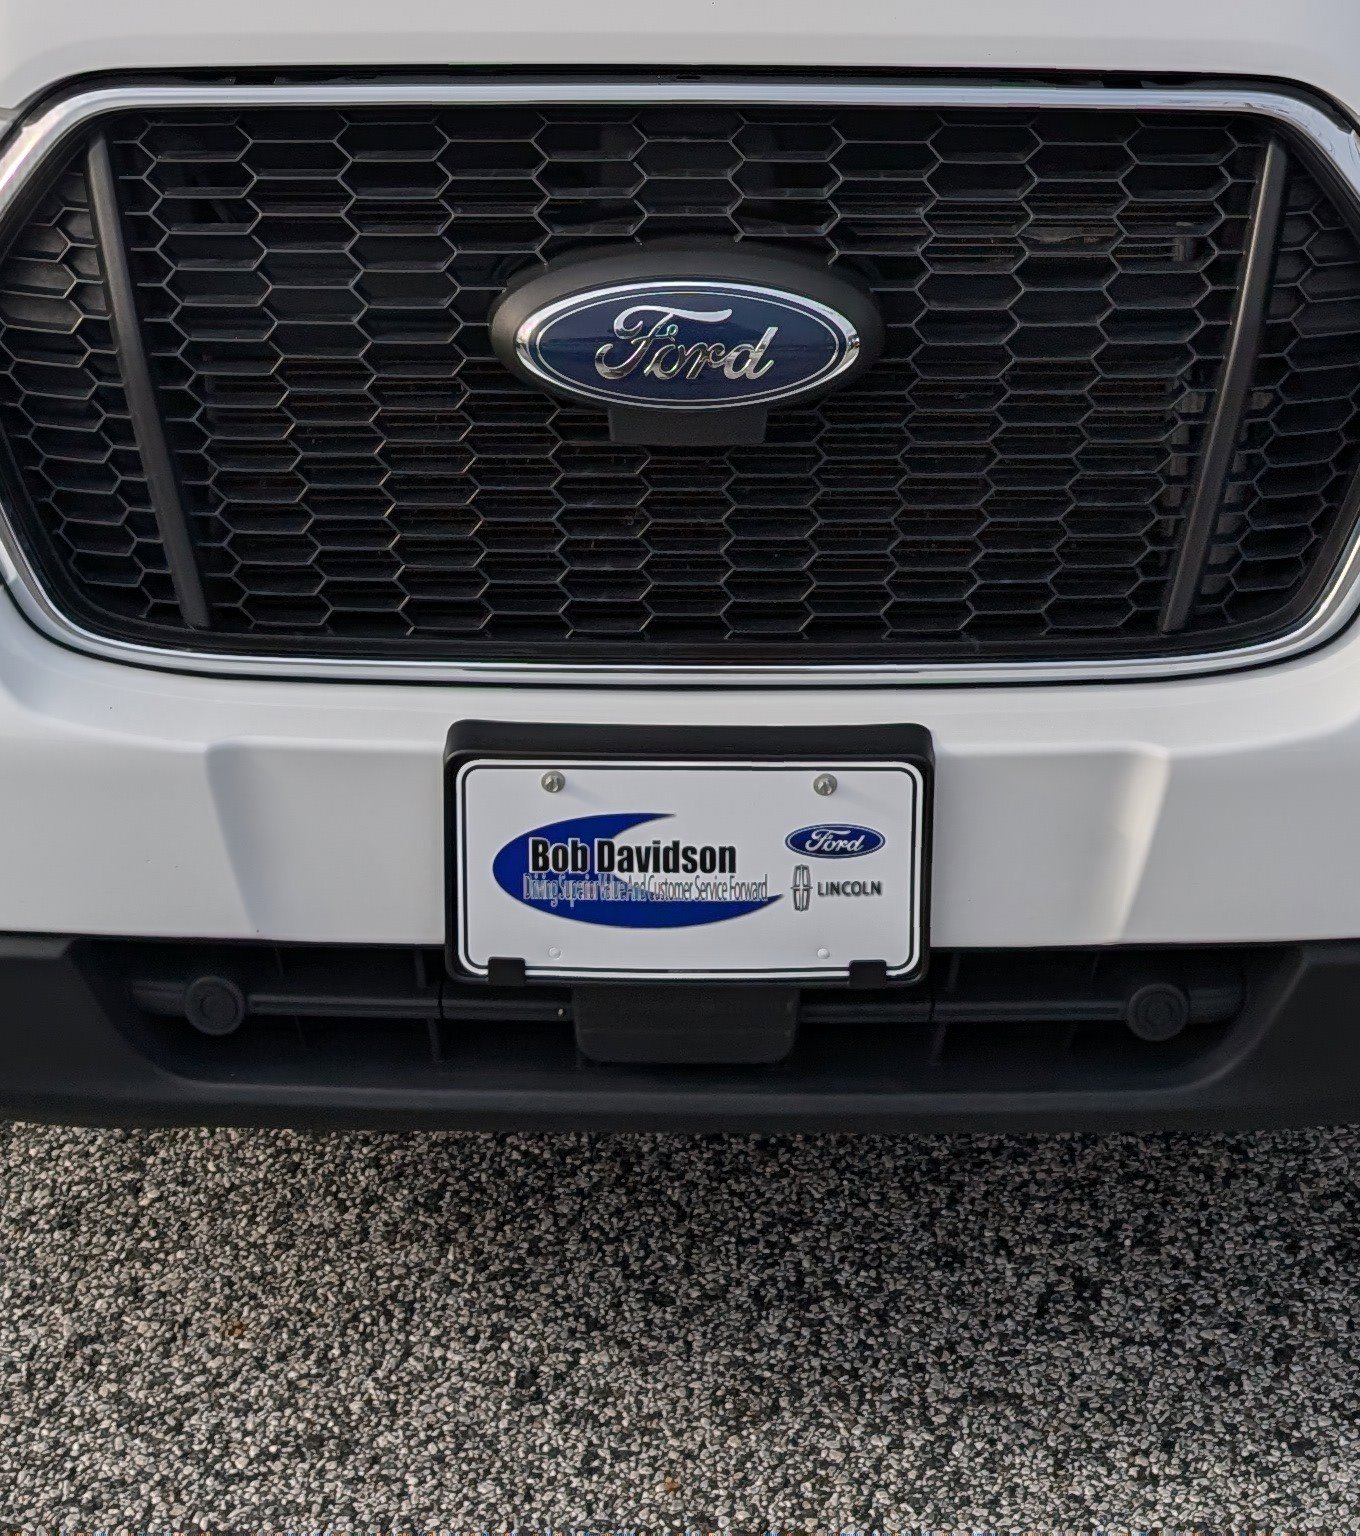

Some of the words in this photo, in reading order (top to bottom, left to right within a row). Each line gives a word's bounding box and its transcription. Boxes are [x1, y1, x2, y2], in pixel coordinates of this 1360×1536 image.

[595, 305, 779, 379] Ford
[805, 829, 865, 851] Ford
[530, 838, 590, 873] Bob
[596, 839, 737, 874] Davidson
[648, 874, 693, 901] Customer
[694, 874, 729, 901] Service
[729, 873, 767, 901] Forward
[817, 881, 882, 896] LINCOLN
